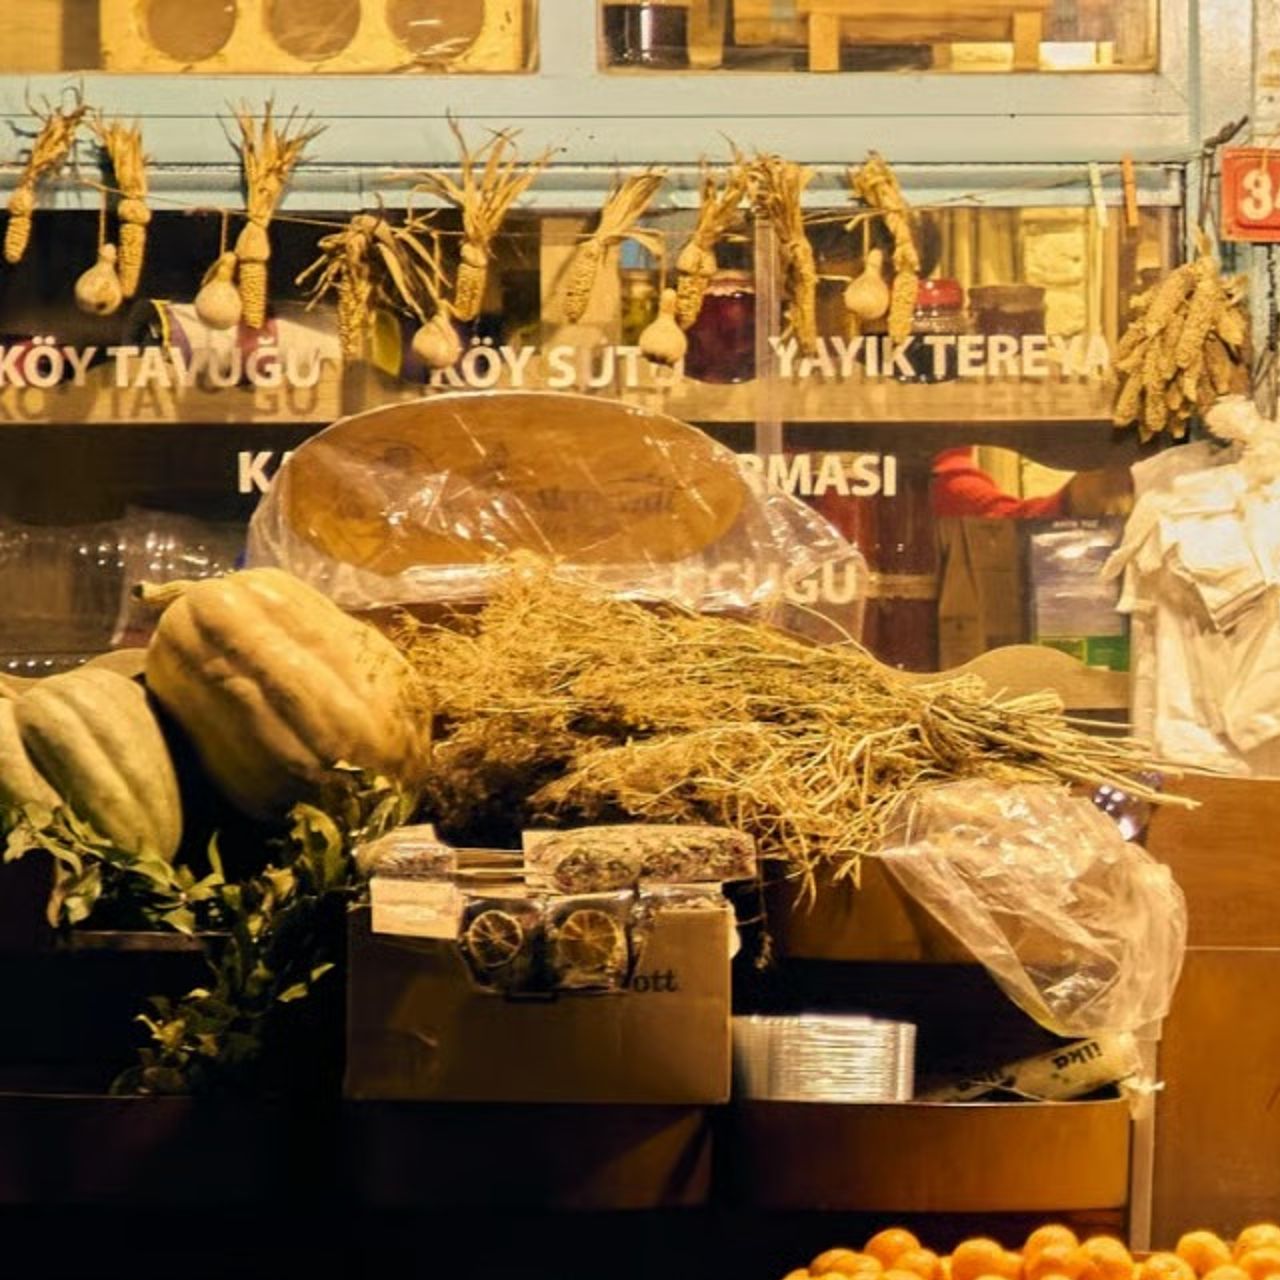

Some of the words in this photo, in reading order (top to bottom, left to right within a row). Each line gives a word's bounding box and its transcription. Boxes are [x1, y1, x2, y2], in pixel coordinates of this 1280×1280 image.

[0, 336, 96, 388] KÖY
[107, 336, 320, 388] TAVUĞU
[768, 335, 915, 378] YAYIK
[923, 334, 1112, 378] TEREYA
